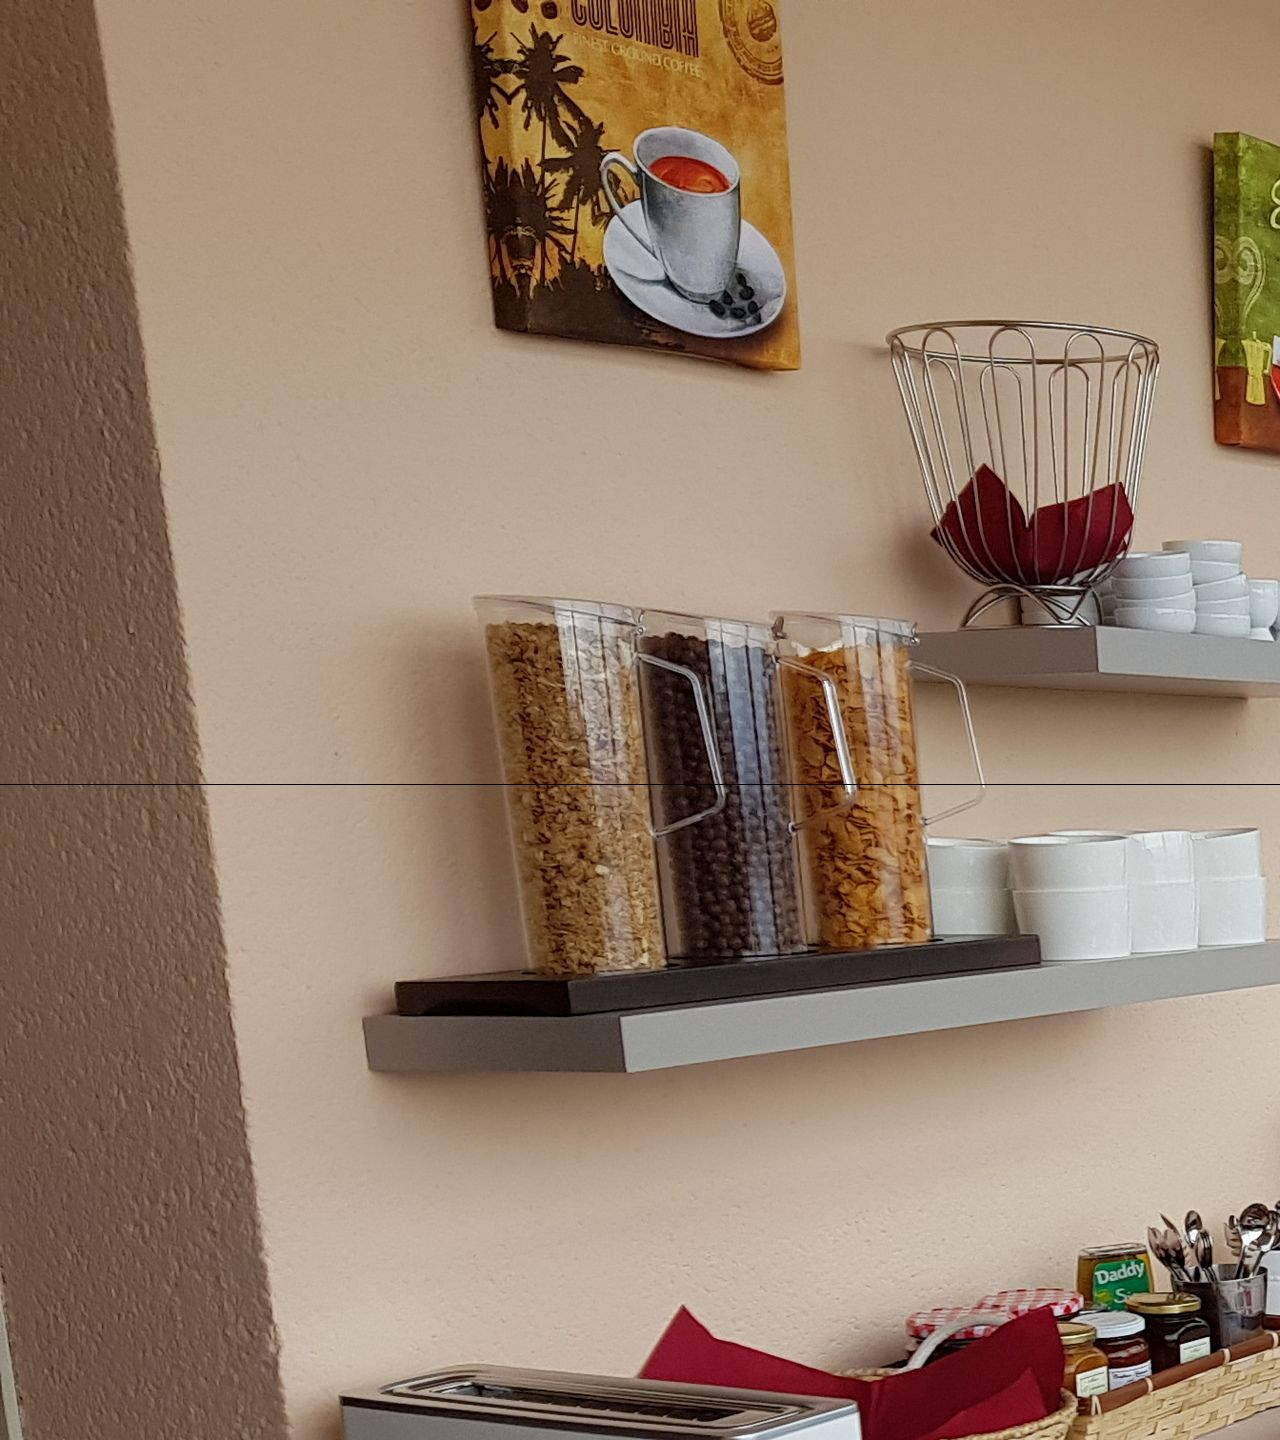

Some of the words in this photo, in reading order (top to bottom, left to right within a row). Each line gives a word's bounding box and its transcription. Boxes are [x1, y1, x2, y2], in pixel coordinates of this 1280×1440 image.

[611, 43, 662, 67] GROUND
[663, 56, 704, 77] COFFEE
[1094, 1261, 1145, 1285] Daddy
